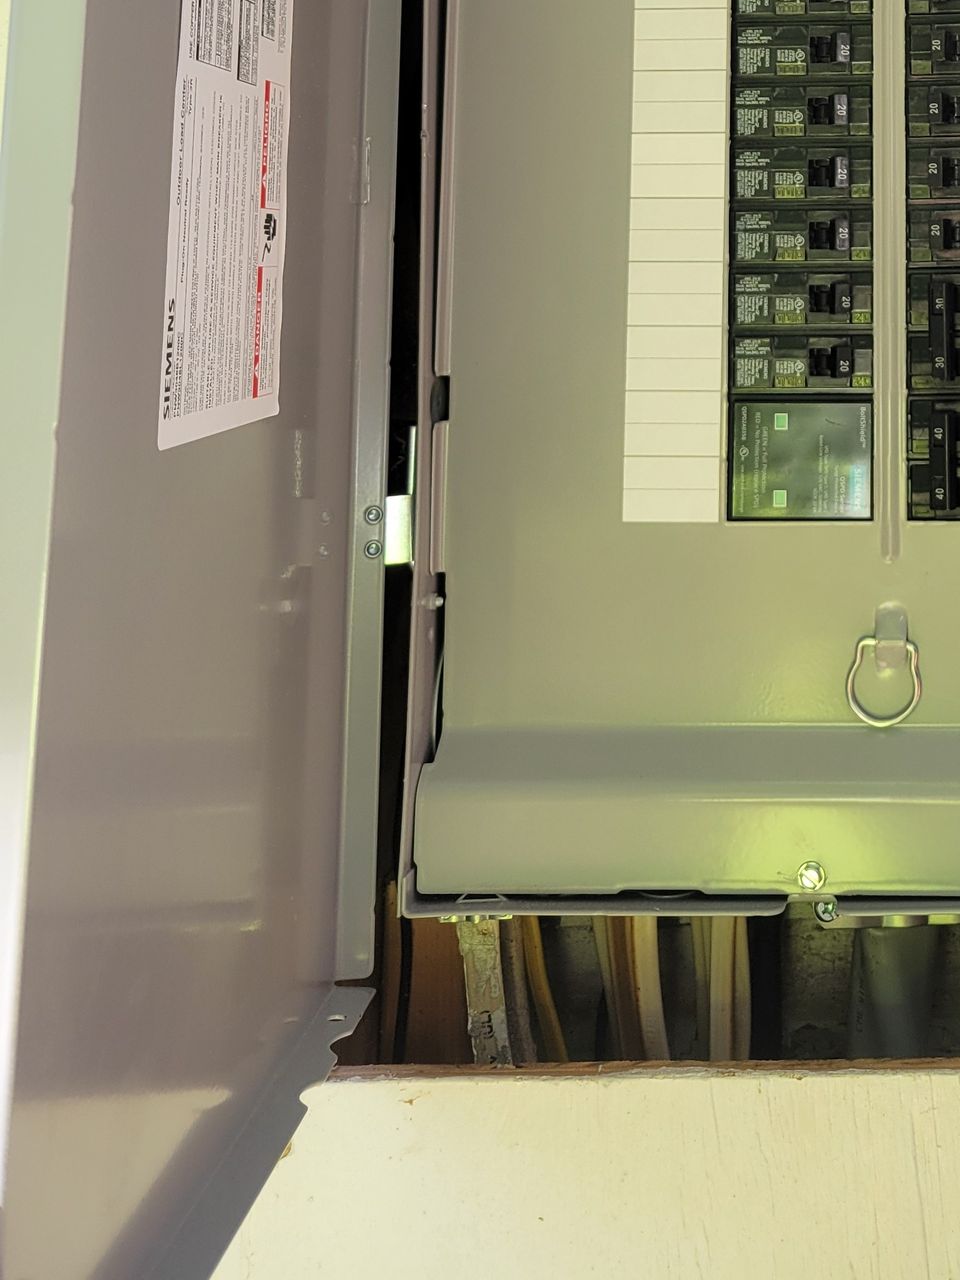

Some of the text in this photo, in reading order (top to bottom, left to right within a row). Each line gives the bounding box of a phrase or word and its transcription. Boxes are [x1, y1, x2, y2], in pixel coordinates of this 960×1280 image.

[840, 44, 850, 56] 20
[932, 39, 941, 51] 20
[837, 104, 846, 116] 20
[929, 103, 939, 114] 20
[928, 162, 938, 174] 20
[838, 169, 847, 180] 20
[839, 228, 848, 239] 20
[931, 224, 940, 236] 20
[842, 296, 851, 308] 20
[935, 297, 945, 309] 30
[163, 298, 175, 421] SIEMENS
[935, 356, 945, 368] 30
[840, 360, 849, 372] 20
[933, 427, 943, 440] 40
[935, 487, 945, 500] 40
